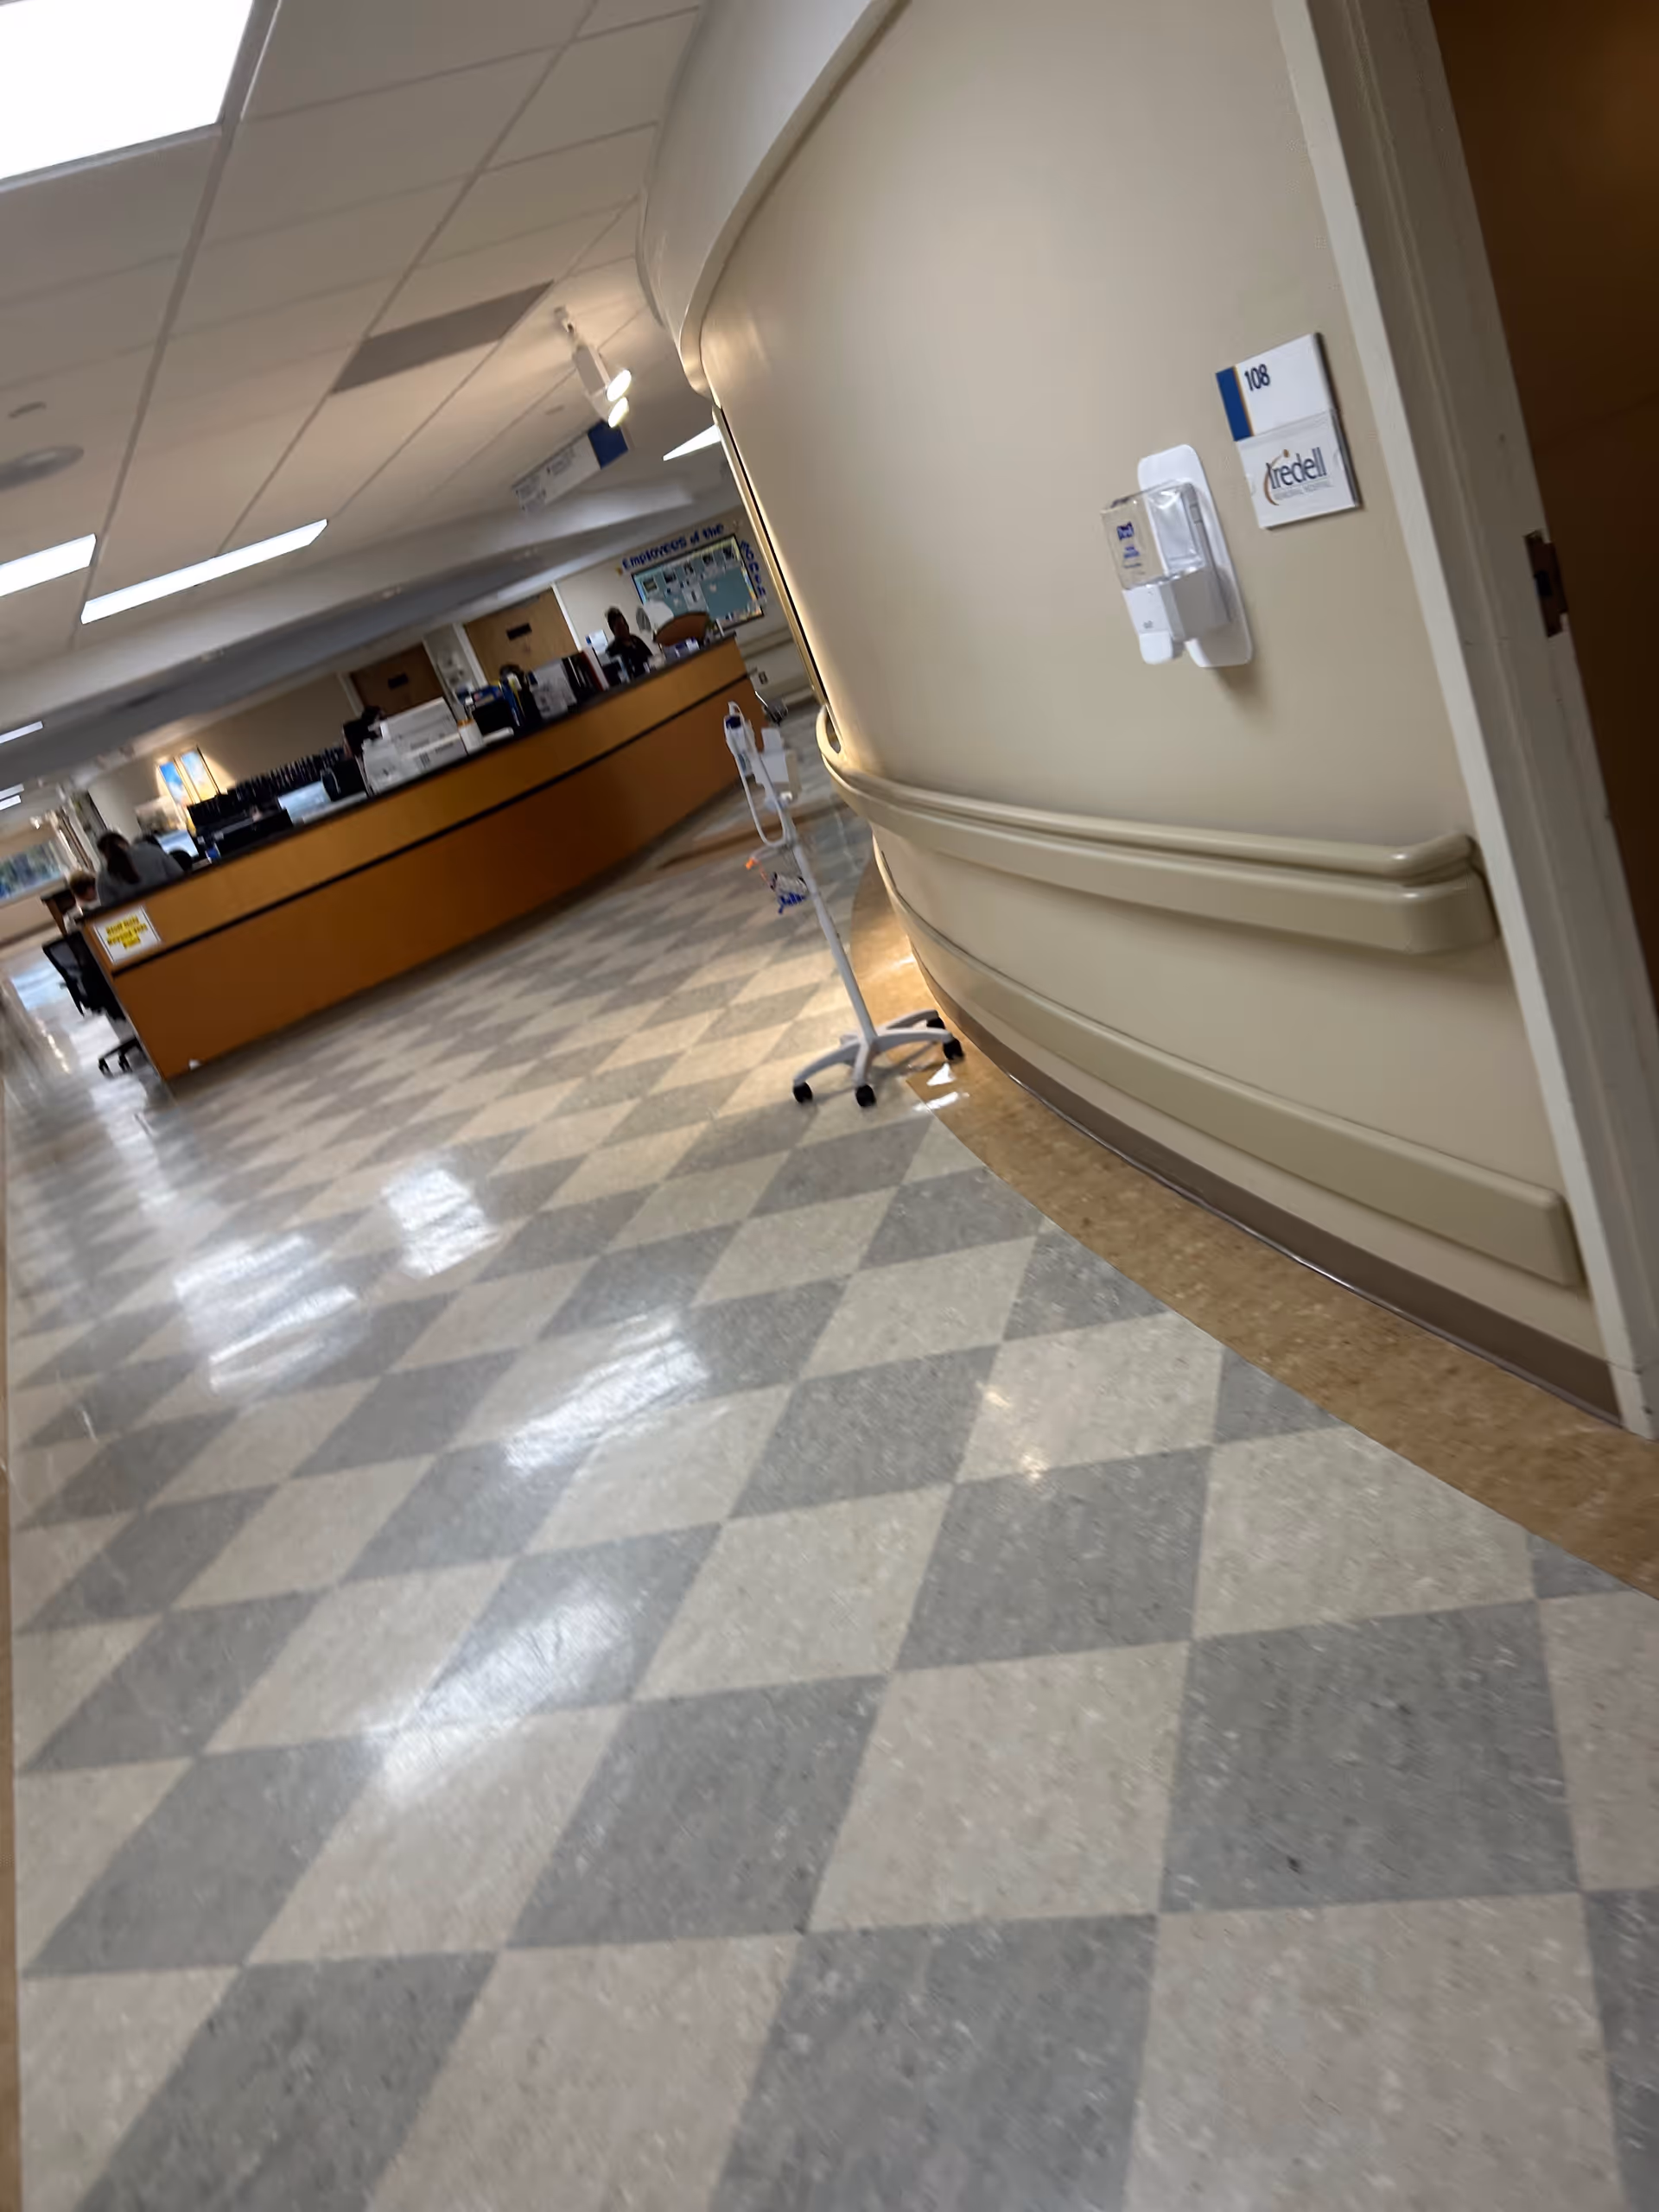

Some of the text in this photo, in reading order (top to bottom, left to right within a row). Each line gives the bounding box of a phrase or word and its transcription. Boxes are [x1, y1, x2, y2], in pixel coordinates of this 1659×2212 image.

[1244, 364, 1270, 391] 108
[1265, 447, 1327, 490] Iredell
[622, 537, 687, 570] Employees
[702, 524, 724, 539] the
